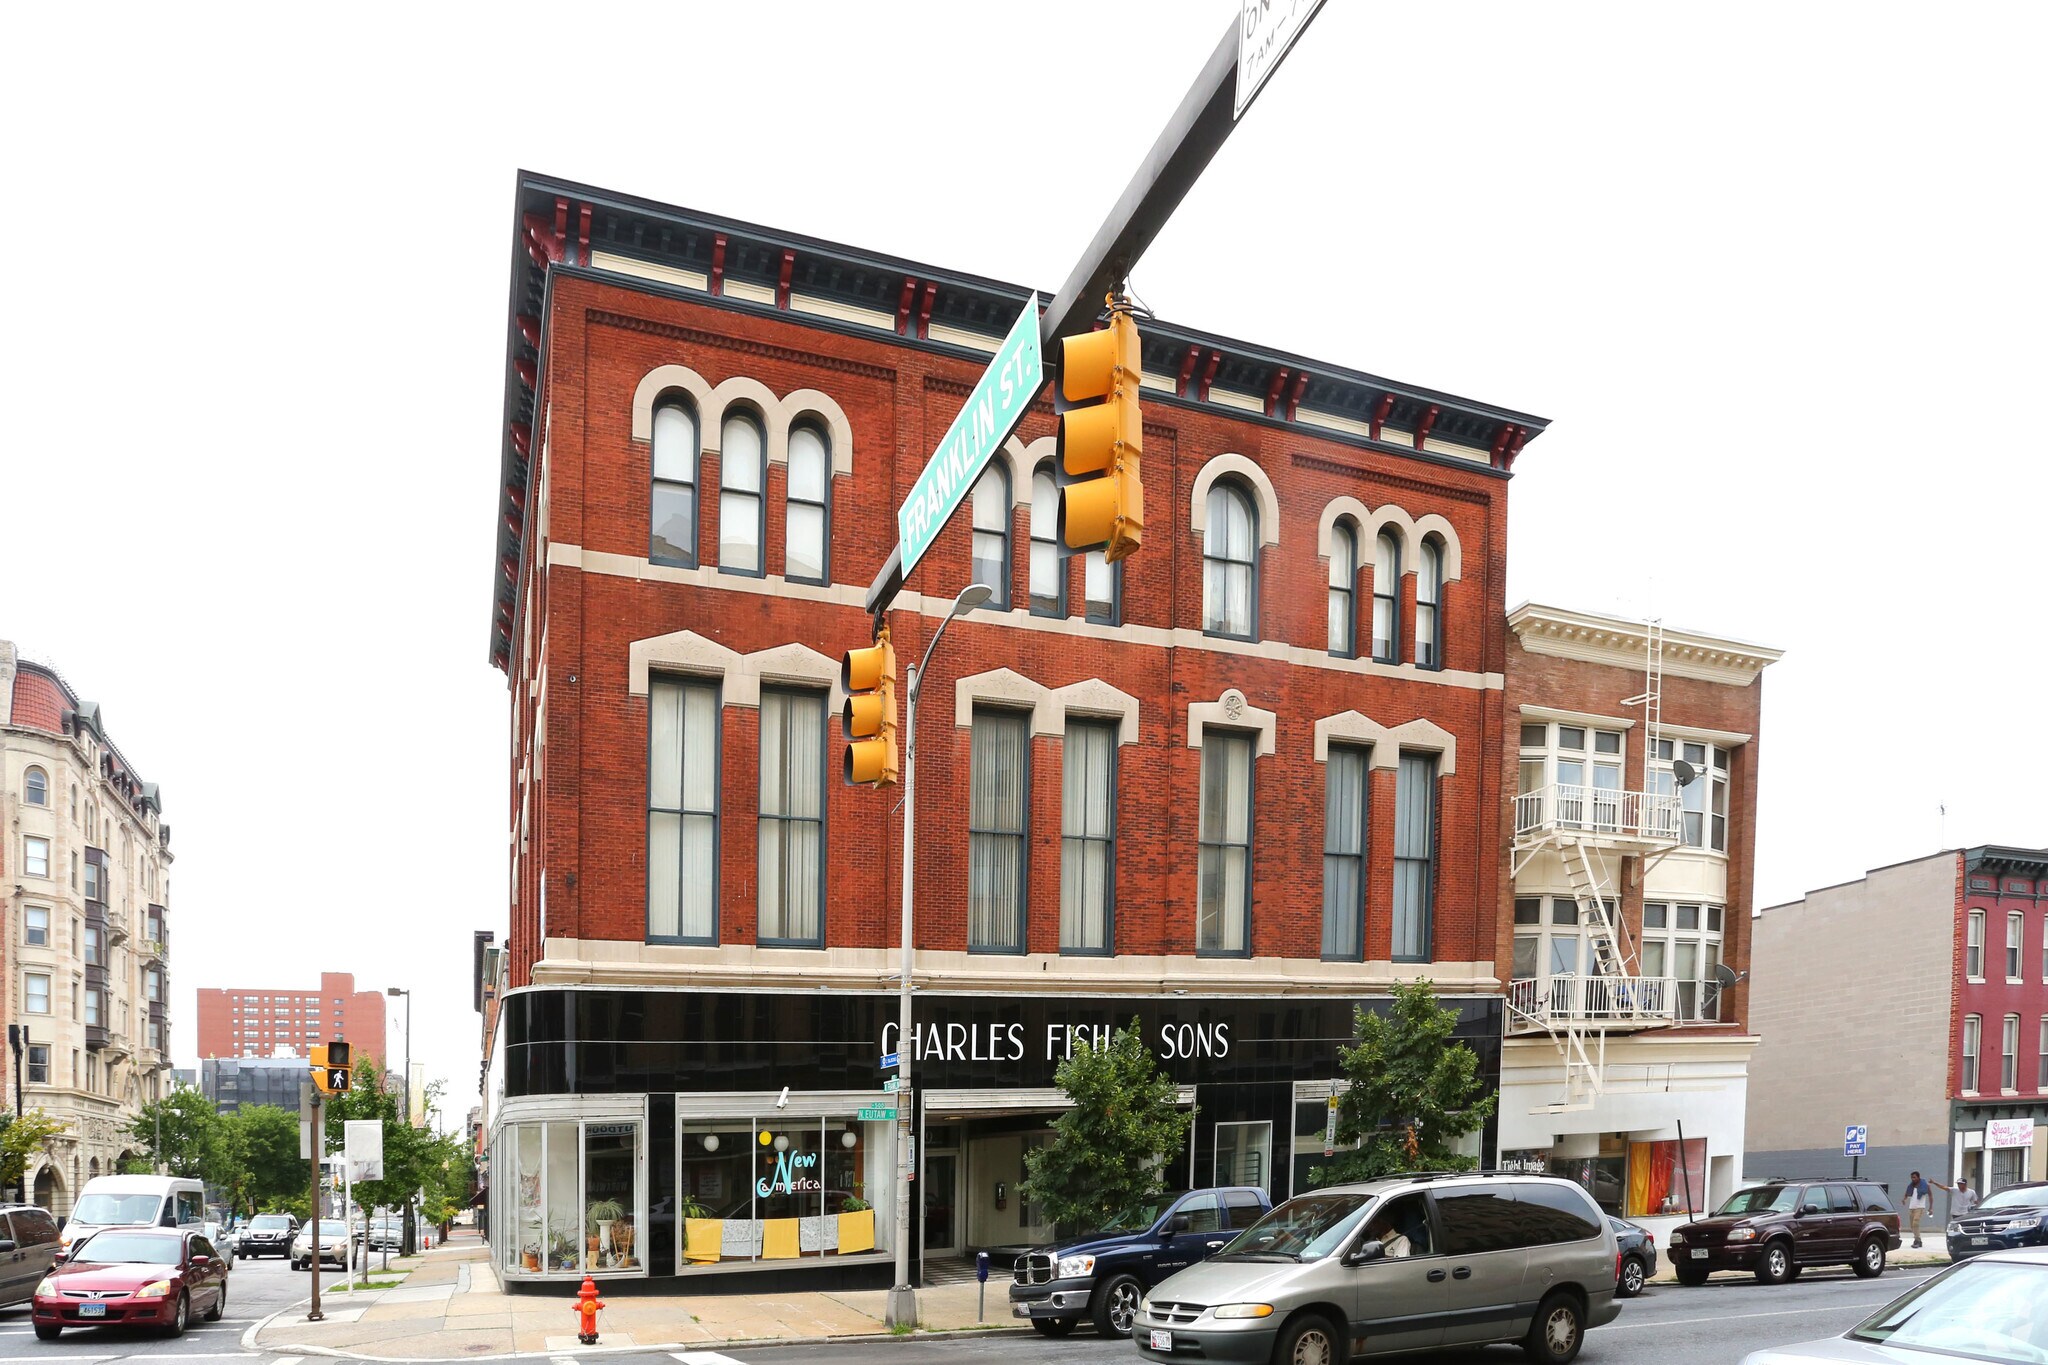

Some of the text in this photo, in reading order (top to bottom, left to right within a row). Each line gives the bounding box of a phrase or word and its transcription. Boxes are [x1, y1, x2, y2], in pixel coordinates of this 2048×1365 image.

[904, 338, 1033, 554] FRANKLIN ST.
[881, 1022, 1024, 1061] CHARLES
[1160, 1023, 1230, 1060] SONS
[865, 1109, 887, 1119] EUTAW
[757, 1150, 817, 1198] New
[1523, 1159, 1545, 1174] Image
